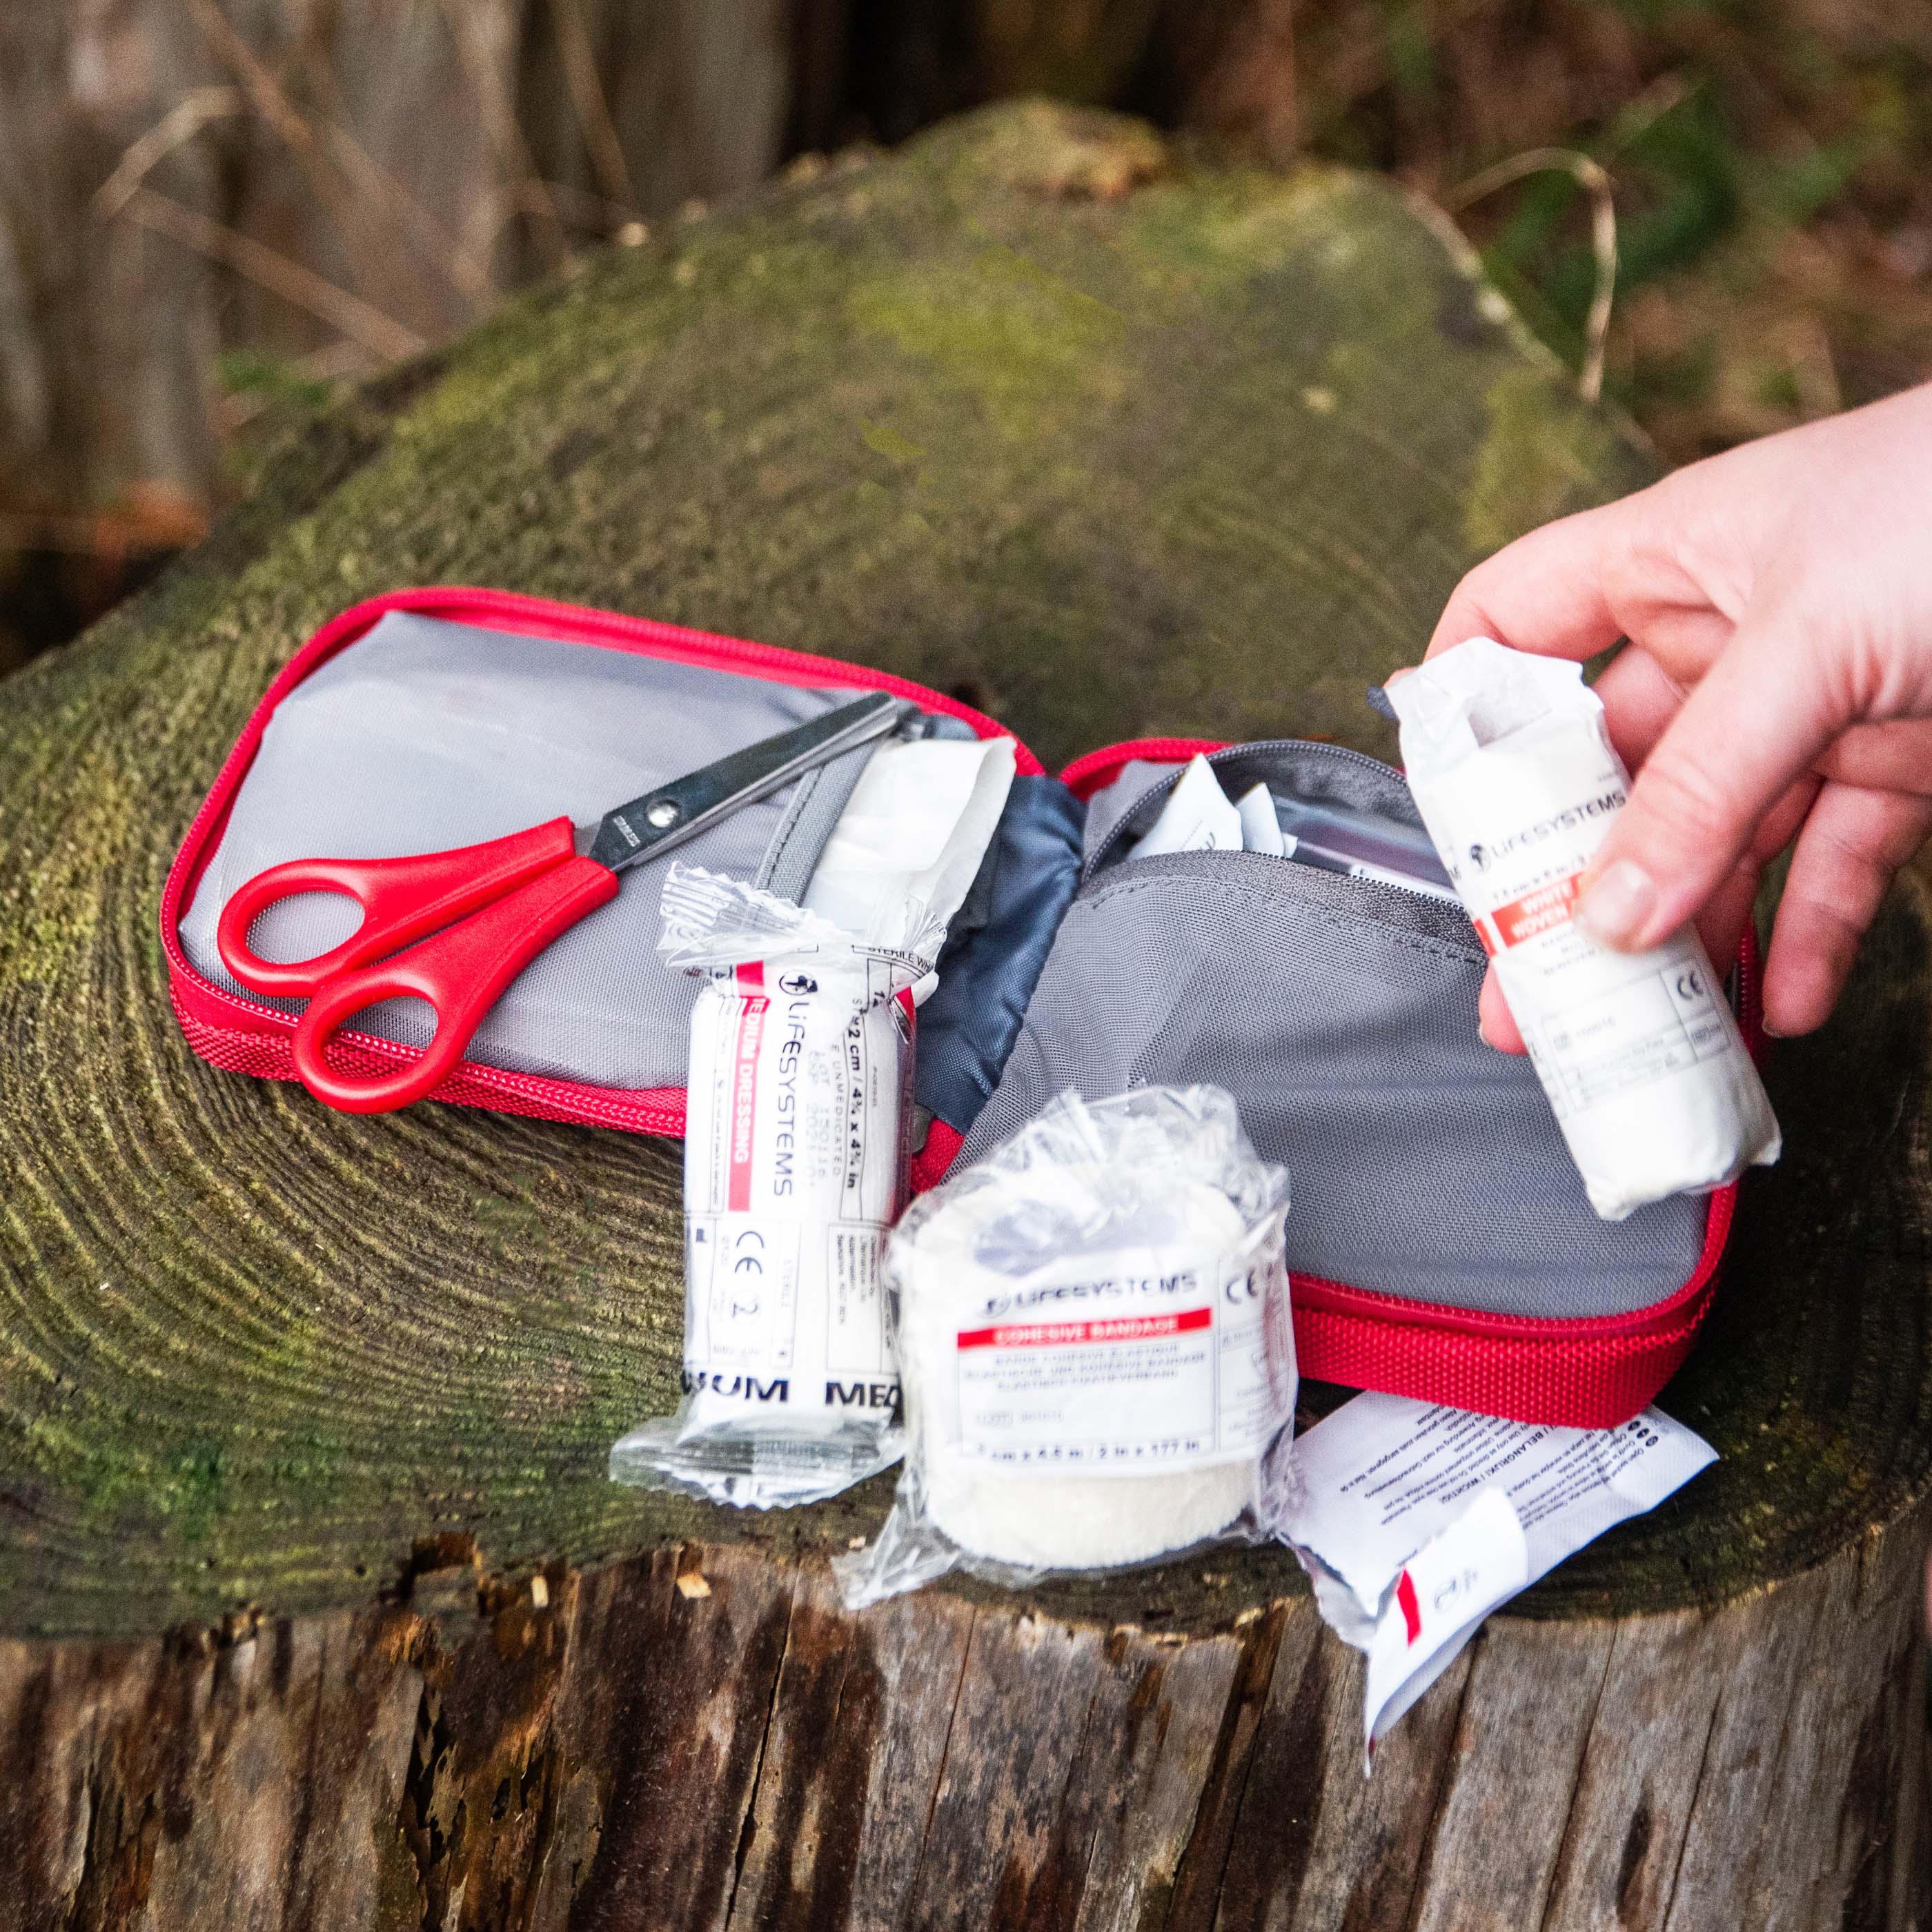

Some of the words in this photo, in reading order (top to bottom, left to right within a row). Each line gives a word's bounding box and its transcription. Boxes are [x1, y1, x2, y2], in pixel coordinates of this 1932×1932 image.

[1511, 903, 1569, 939] WOVEN
[849, 1045, 860, 1070] cm
[734, 1063, 757, 1163] DRESSING
[847, 1172, 857, 1188] in
[994, 1323, 1085, 1346] COHESIVE
[1090, 1318, 1179, 1341] BANDAGE
